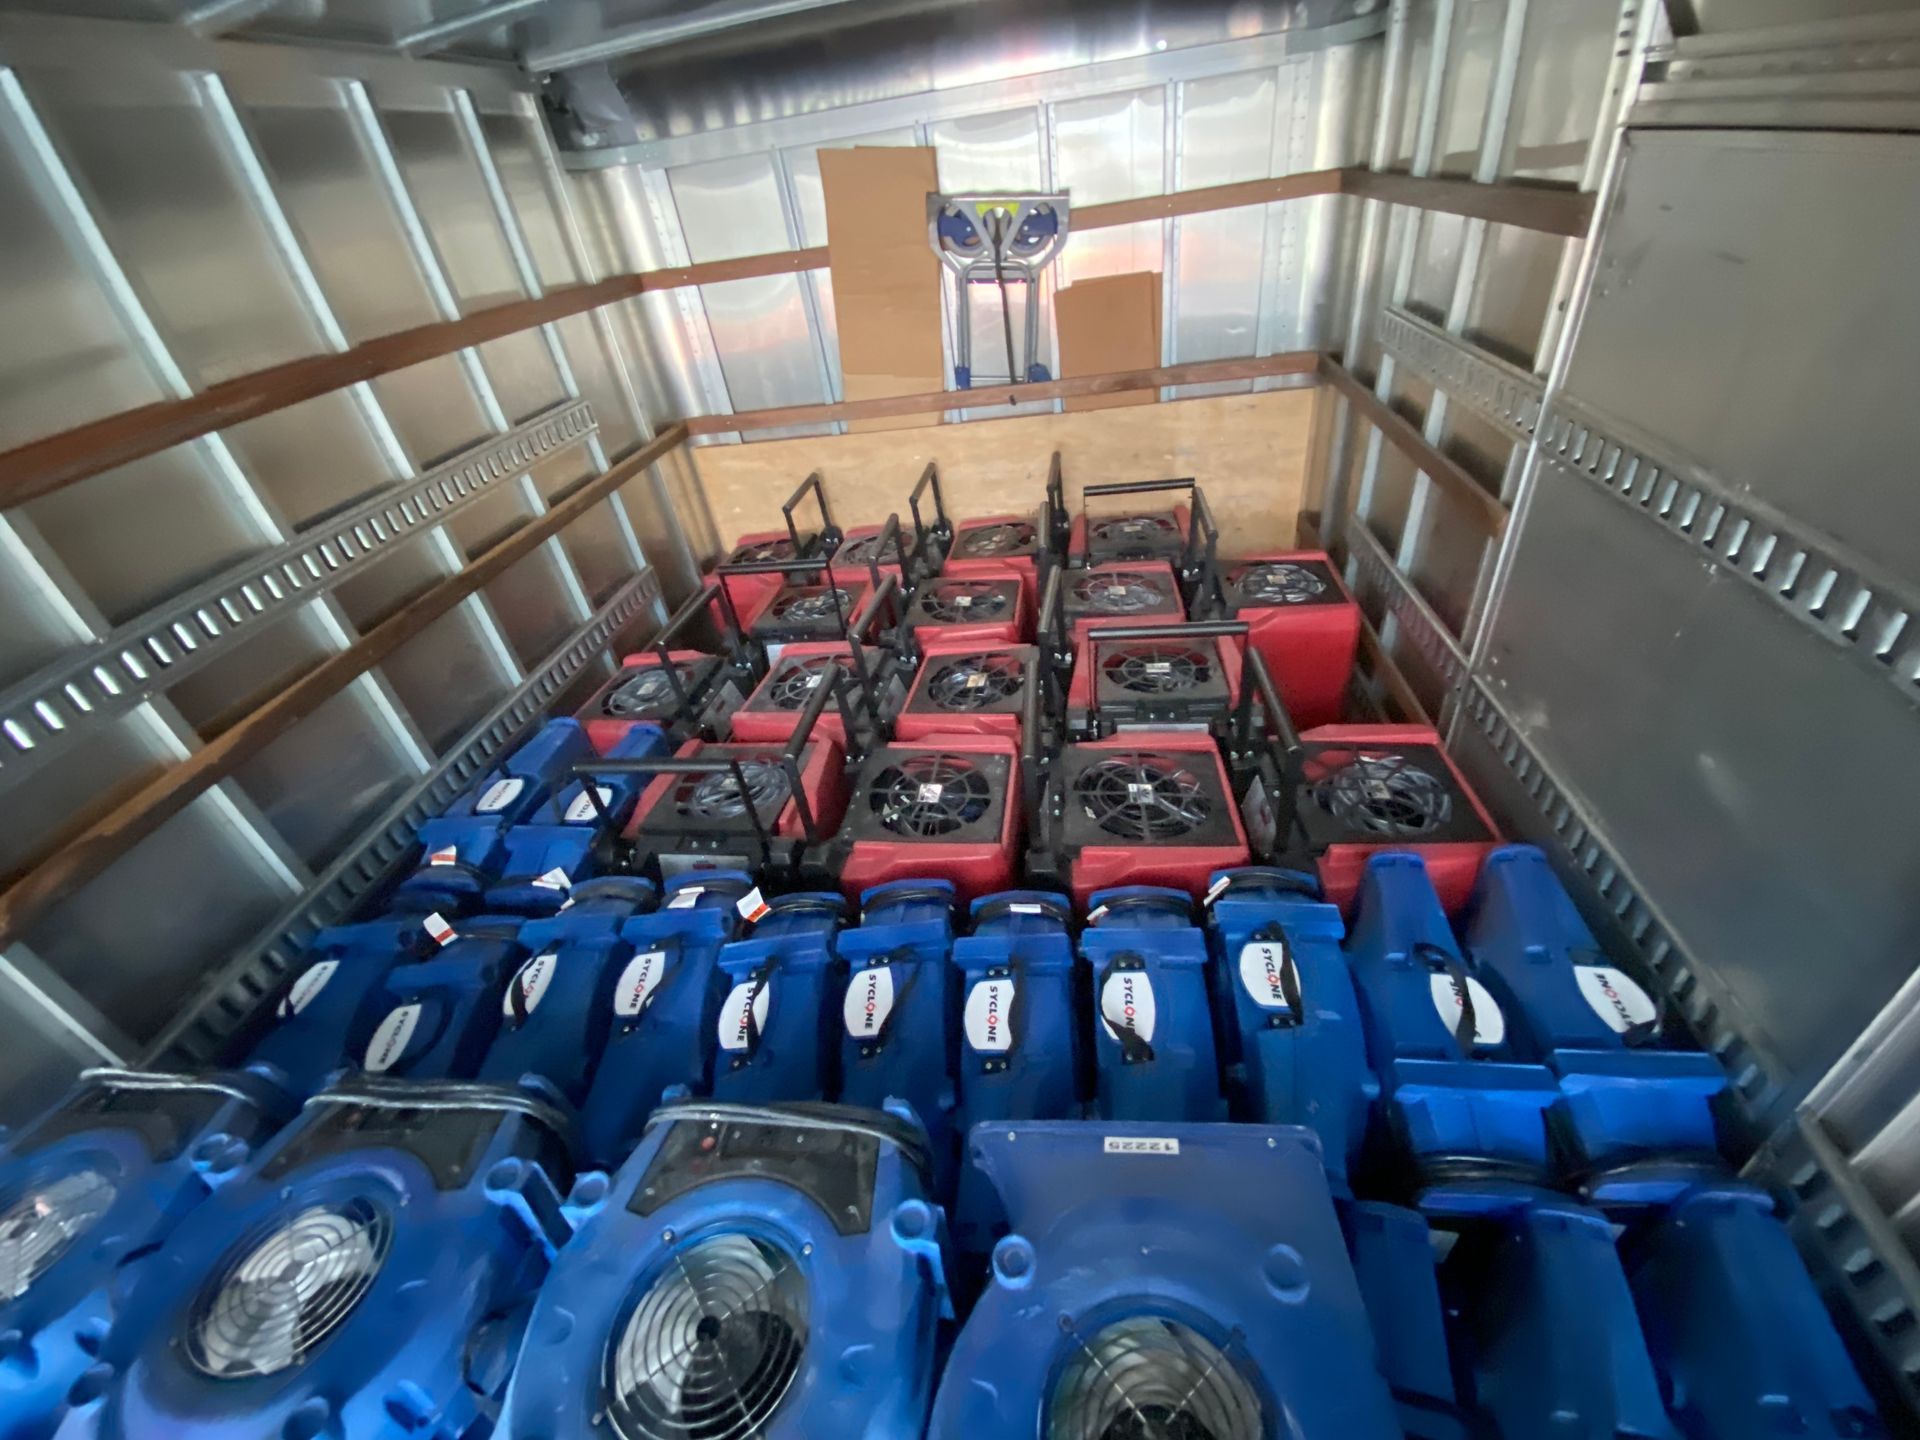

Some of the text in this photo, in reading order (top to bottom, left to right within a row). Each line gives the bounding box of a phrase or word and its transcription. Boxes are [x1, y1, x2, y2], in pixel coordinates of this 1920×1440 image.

[631, 957, 652, 1009] SYCLONE
[1262, 947, 1282, 1000] SYCLONE
[864, 974, 878, 1029] SYCLONE
[987, 985, 1001, 1043] SYCLONE
[1123, 977, 1136, 1028] SYCLON
